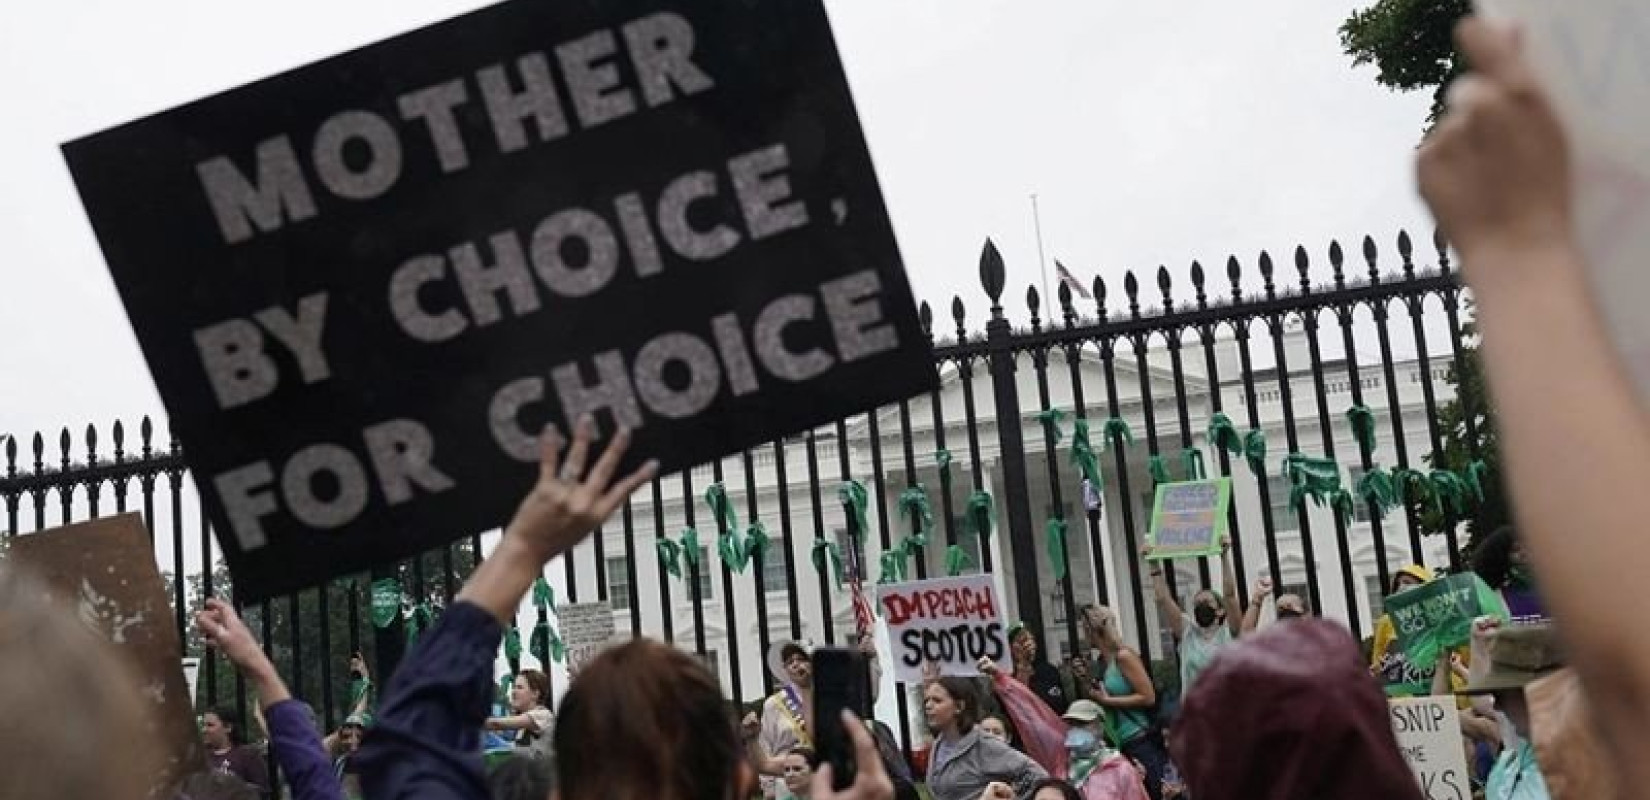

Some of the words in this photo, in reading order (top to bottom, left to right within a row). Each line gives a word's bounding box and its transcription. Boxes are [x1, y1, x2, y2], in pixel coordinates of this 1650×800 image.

[197, 11, 714, 245] MOTHER
[193, 292, 331, 410] BY
[213, 420, 456, 552] FOR
[489, 269, 900, 464] CHOICE
[882, 585, 995, 626] IMPEACH
[1400, 616, 1426, 634] GO
[901, 623, 1004, 667] SCOTUS
[1391, 703, 1445, 733] SNIP
